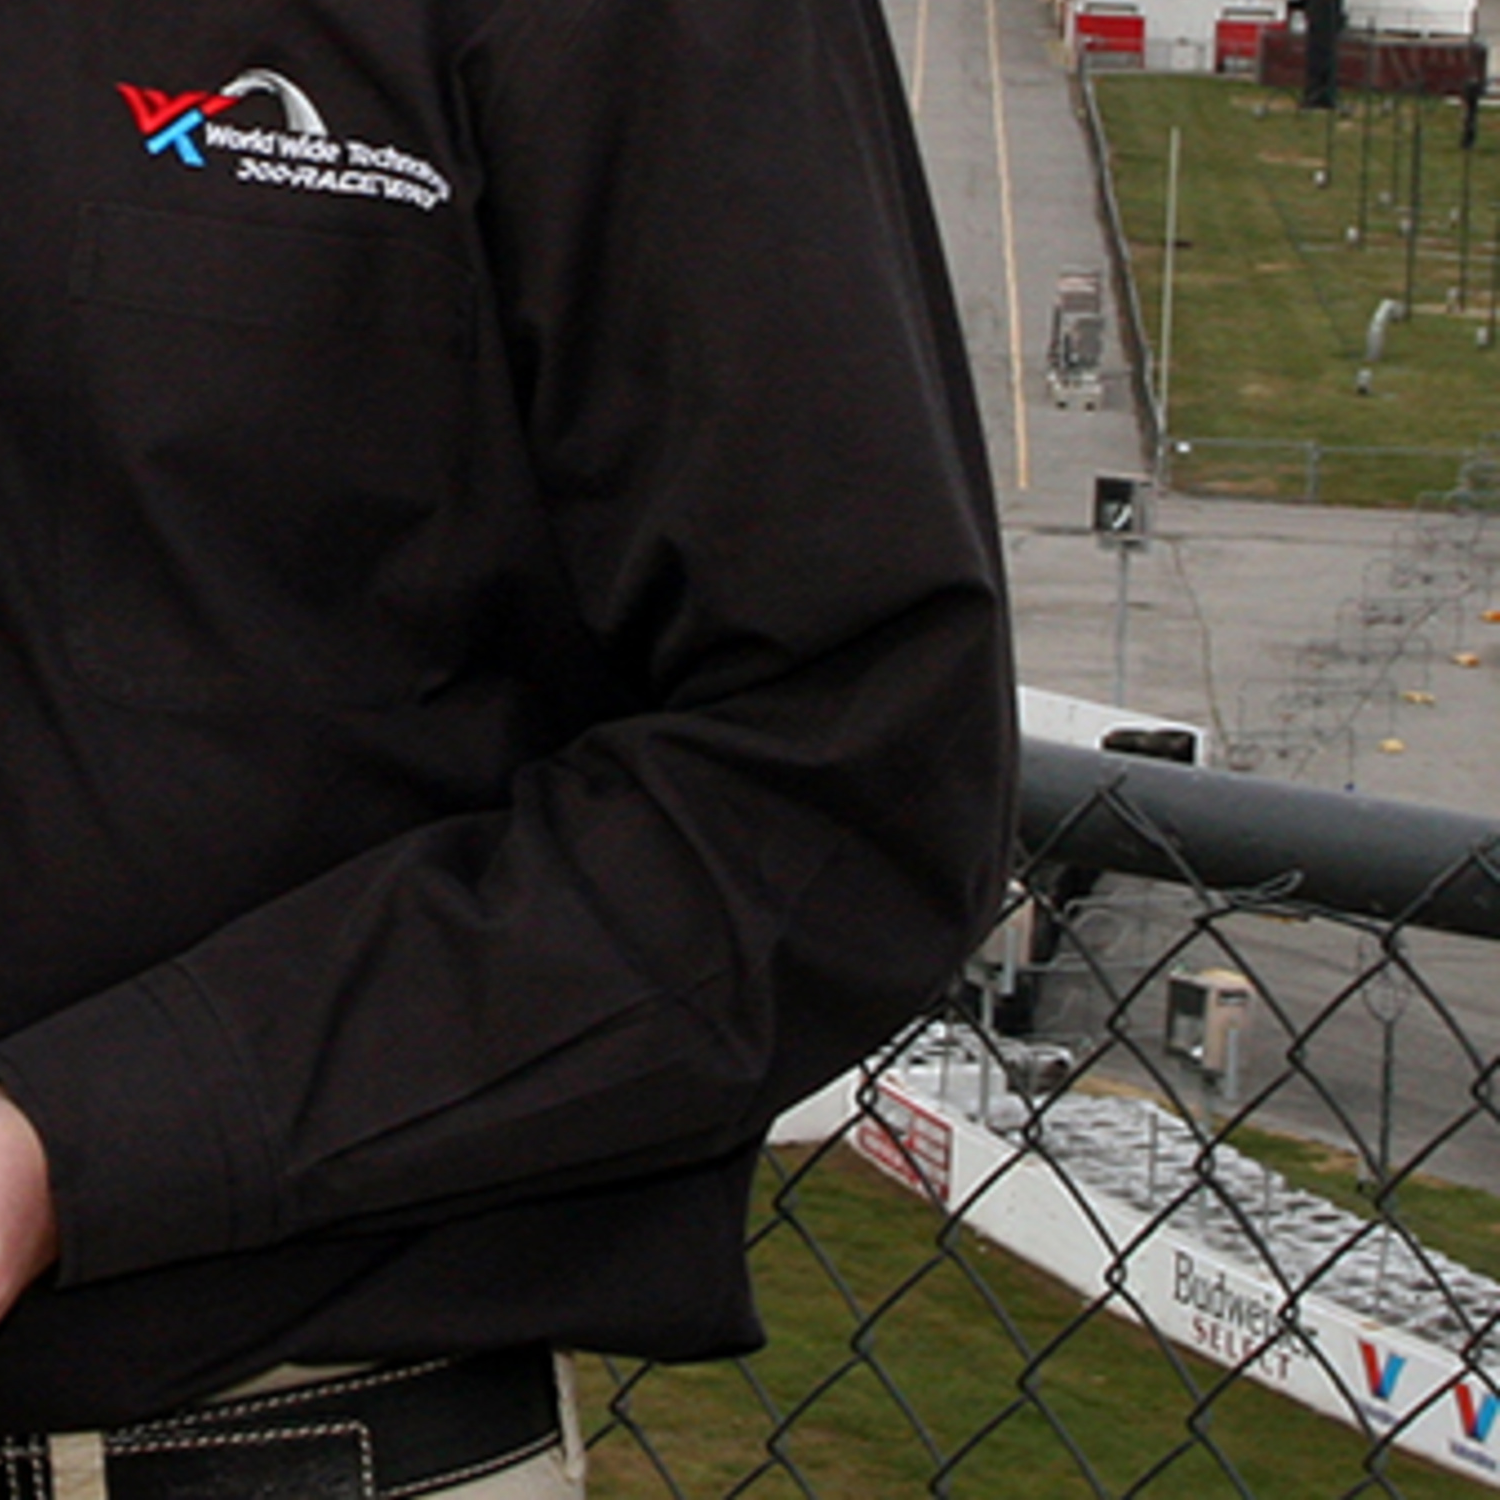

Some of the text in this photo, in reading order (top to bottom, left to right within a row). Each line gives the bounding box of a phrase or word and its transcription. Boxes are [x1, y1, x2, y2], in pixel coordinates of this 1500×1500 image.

[205, 121, 451, 201] World Wide Techno
[1174, 1250, 1318, 1358] Budwei
